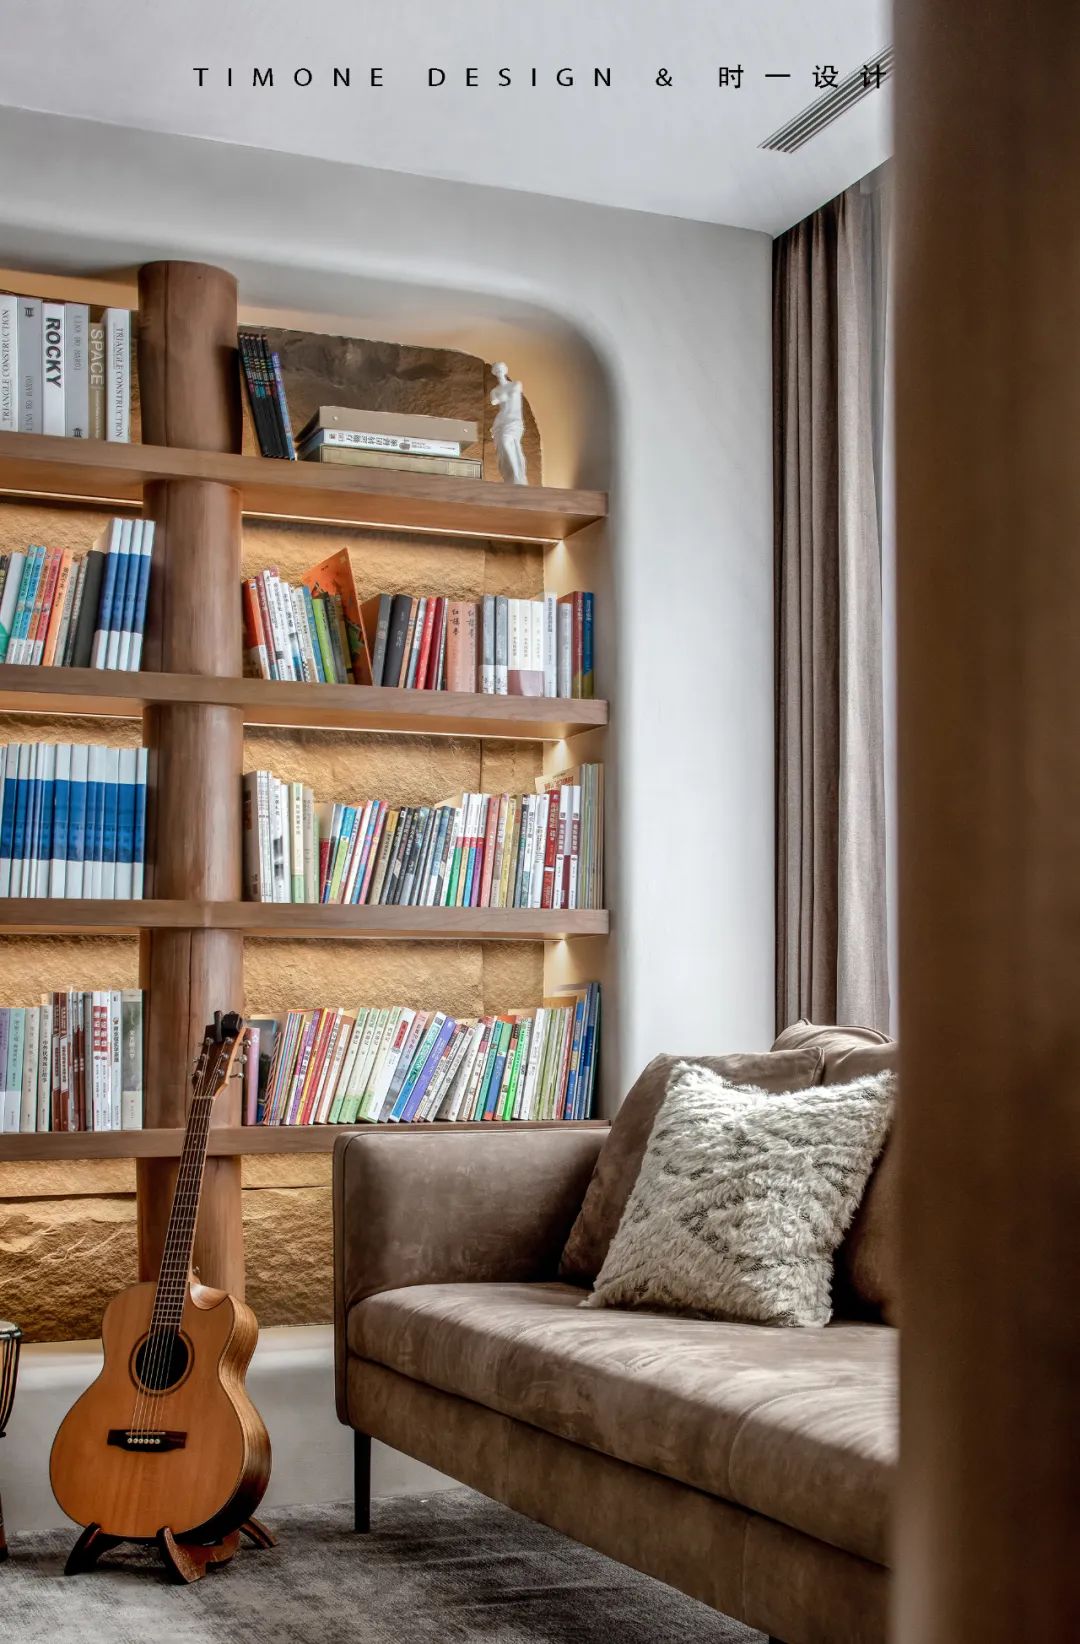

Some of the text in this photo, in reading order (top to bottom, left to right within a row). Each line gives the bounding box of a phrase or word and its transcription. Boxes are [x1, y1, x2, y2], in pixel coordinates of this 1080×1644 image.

[45, 317, 62, 389] ROCKY
[90, 328, 104, 386] SPACE
[115, 328, 125, 438] TRIANGLE CONSTRUCTION
